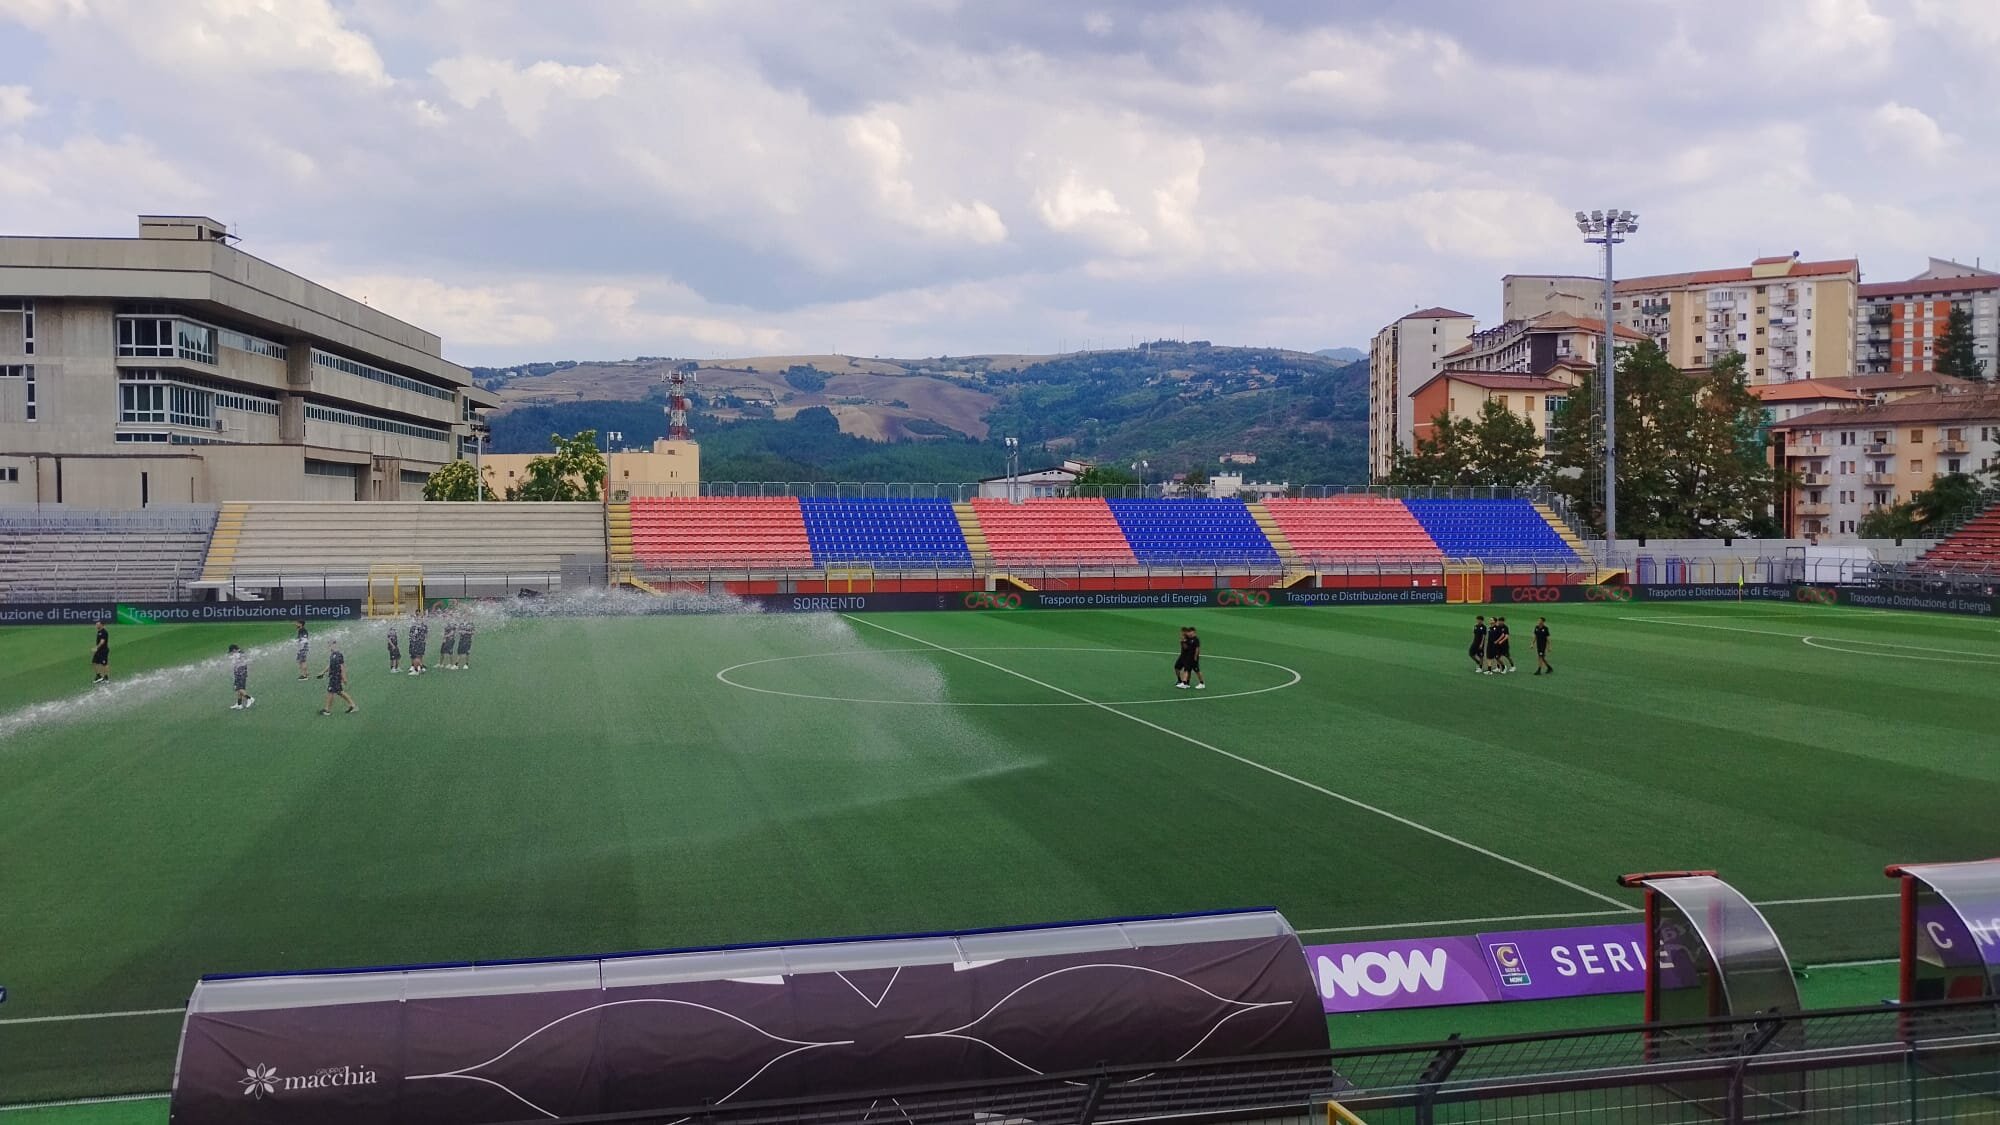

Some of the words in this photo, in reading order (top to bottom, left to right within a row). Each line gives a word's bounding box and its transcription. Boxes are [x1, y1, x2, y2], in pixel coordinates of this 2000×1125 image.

[964, 593, 1022, 609] CARGO
[1039, 595, 1086, 606] Trasporto
[1095, 594, 1158, 604] Distribuzione
[1160, 593, 1170, 603] di
[1172, 593, 1207, 604] Energia
[1217, 590, 1270, 605] CARGO
[1287, 592, 1330, 603] Trasporto
[1339, 591, 1399, 601] Distribuzione
[1400, 591, 1409, 600] di
[1411, 590, 1443, 602] Energia
[1512, 587, 1560, 601] CARGO
[1586, 586, 1633, 601] CARGO
[1648, 588, 1686, 598] Trasporto
[1688, 589, 1694, 597] e
[1696, 587, 1749, 596] Distribuzione
[1751, 586, 1761, 596] di
[1763, 587, 1790, 599] Energia
[793, 597, 865, 610] SORRENTO
[1850, 592, 1886, 605] Trasporto
[1887, 596, 1893, 605] e
[1893, 595, 1948, 608] Distribuzione
[1949, 598, 1957, 609] di
[1959, 600, 1991, 613] Energia
[47, 608, 60, 620] di
[63, 608, 112, 621] Energia
[128, 607, 189, 622] Trasporto
[192, 609, 200, 618] e
[203, 605, 287, 618] Distribuzione
[290, 605, 302, 616] di
[305, 604, 351, 618] Energia
[1926, 921, 1953, 949] C
[1317, 948, 1447, 999] NOW
[284, 1064, 377, 1090] macchia
